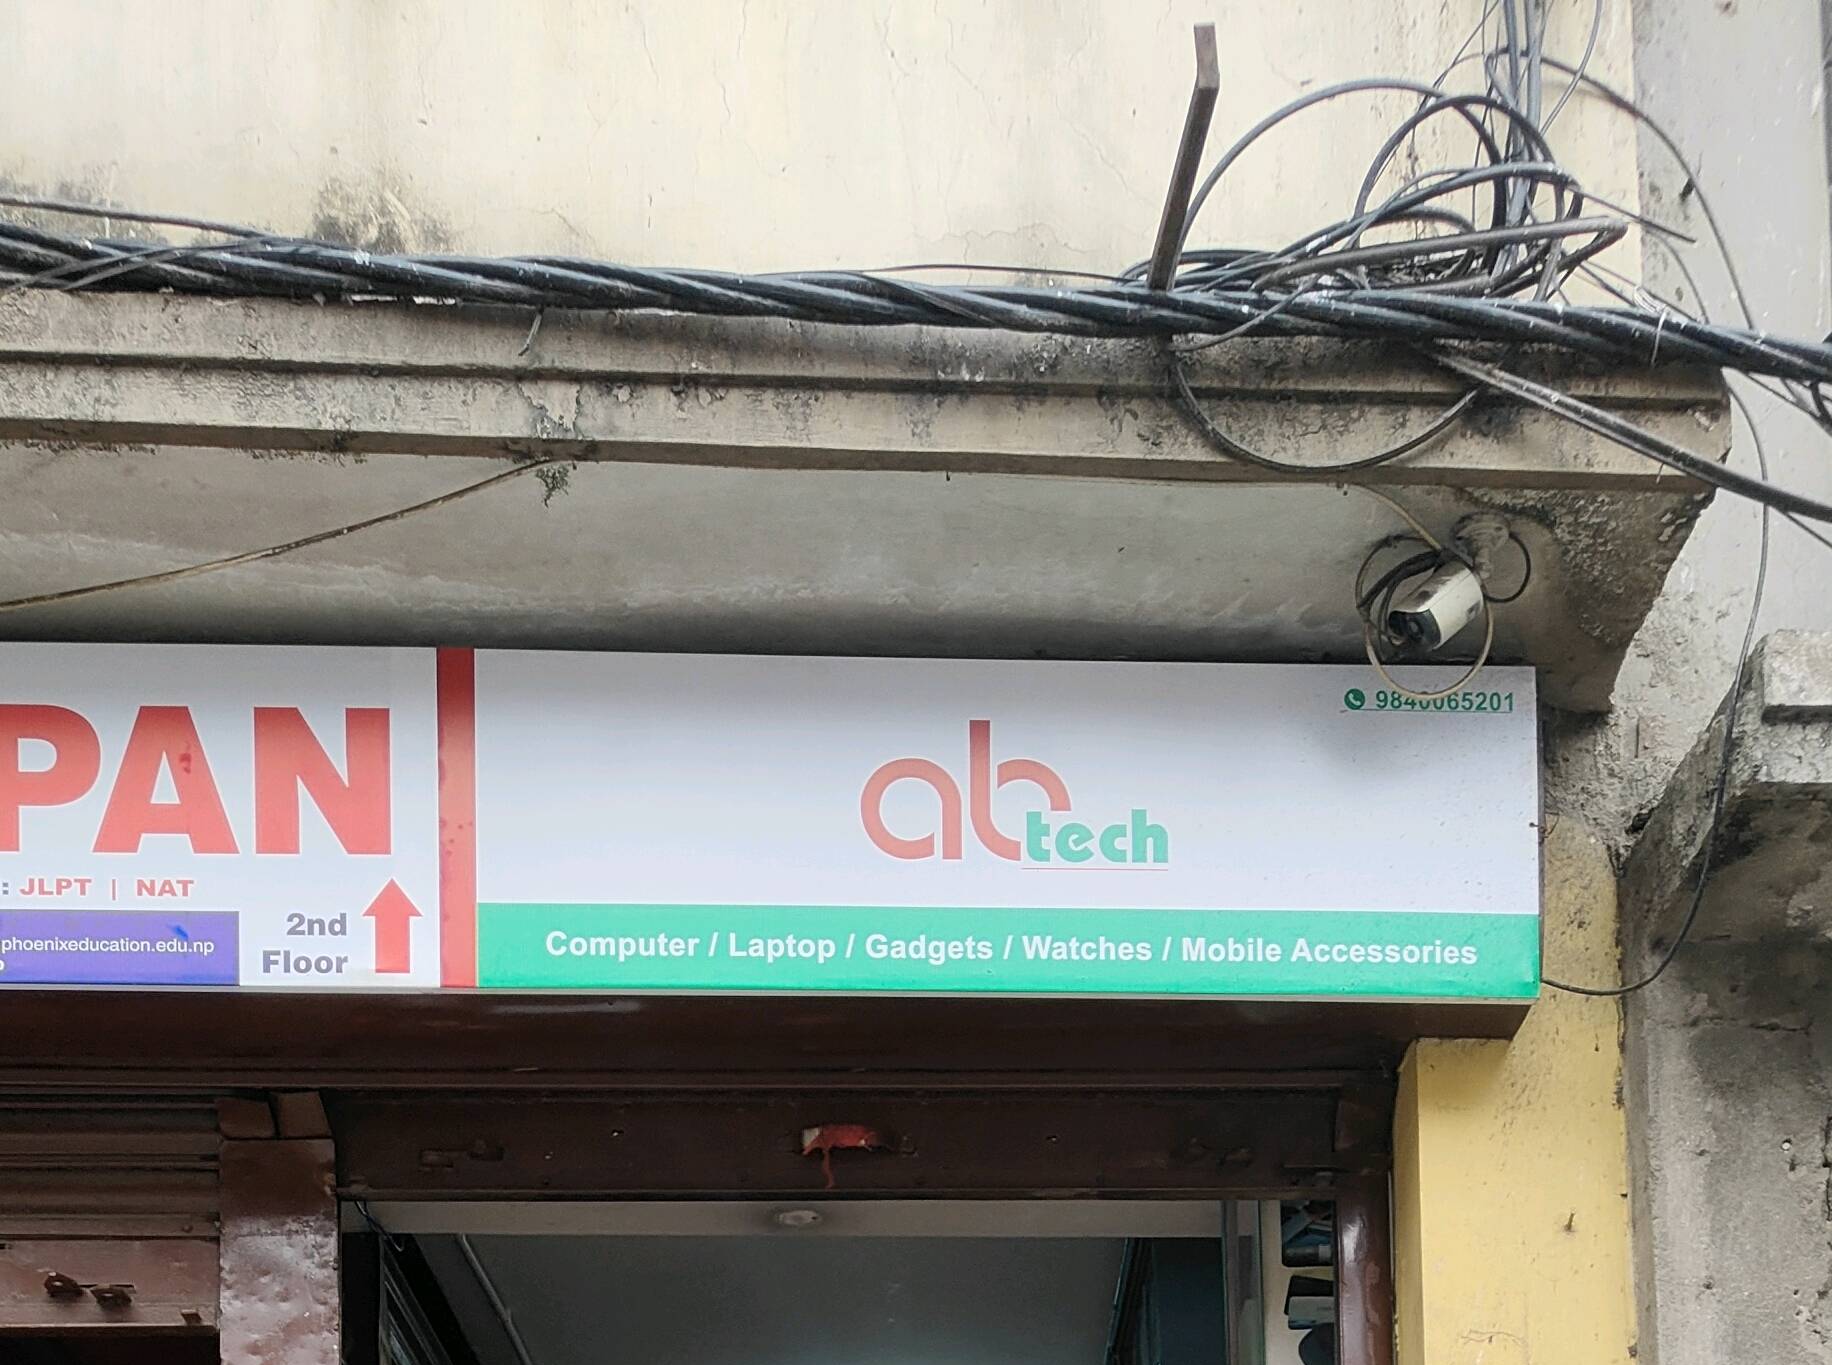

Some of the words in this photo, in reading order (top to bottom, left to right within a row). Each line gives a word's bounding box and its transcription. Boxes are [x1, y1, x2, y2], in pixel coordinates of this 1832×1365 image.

[1376, 690, 1514, 712] 9840065201
[0, 704, 392, 856] PAN
[1027, 809, 1169, 864] tech
[19, 878, 92, 897] JLPT
[136, 879, 195, 897] NAT
[286, 912, 348, 938] 2nd
[1, 936, 215, 956] phoenixeducation.edu.np
[546, 931, 699, 962] Computer
[729, 933, 836, 963] Laptop
[866, 934, 993, 965] Gadgets
[1022, 936, 1152, 961] Watches
[1182, 938, 1282, 963] Mobile
[1291, 939, 1478, 965] Accessories
[262, 949, 349, 976] Floor
